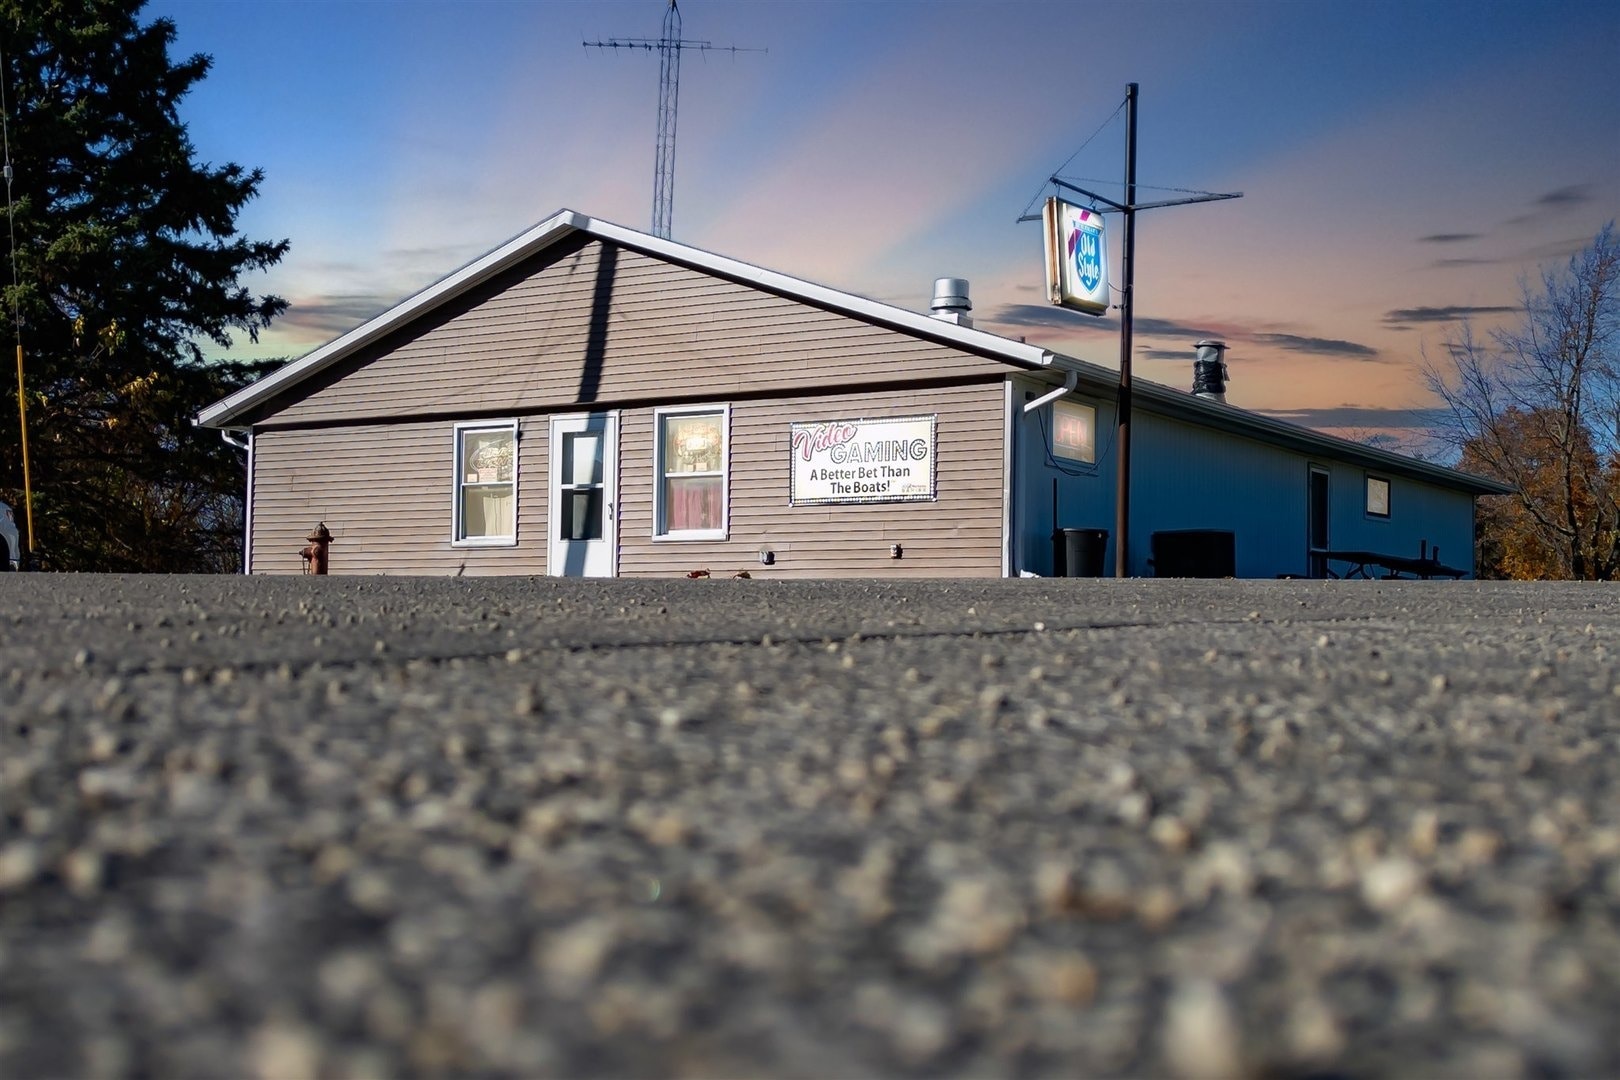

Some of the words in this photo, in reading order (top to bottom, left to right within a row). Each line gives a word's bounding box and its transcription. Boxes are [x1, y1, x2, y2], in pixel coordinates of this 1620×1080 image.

[1081, 233, 1096, 257] Old
[1078, 252, 1099, 286] Style
[793, 423, 857, 461] Video
[830, 439, 927, 464] GAMING
[810, 469, 818, 481] A
[821, 468, 856, 480] Better
[858, 467, 878, 479] Bet
[880, 465, 910, 478] Than
[830, 482, 851, 494] The
[854, 480, 890, 493] Boats!
